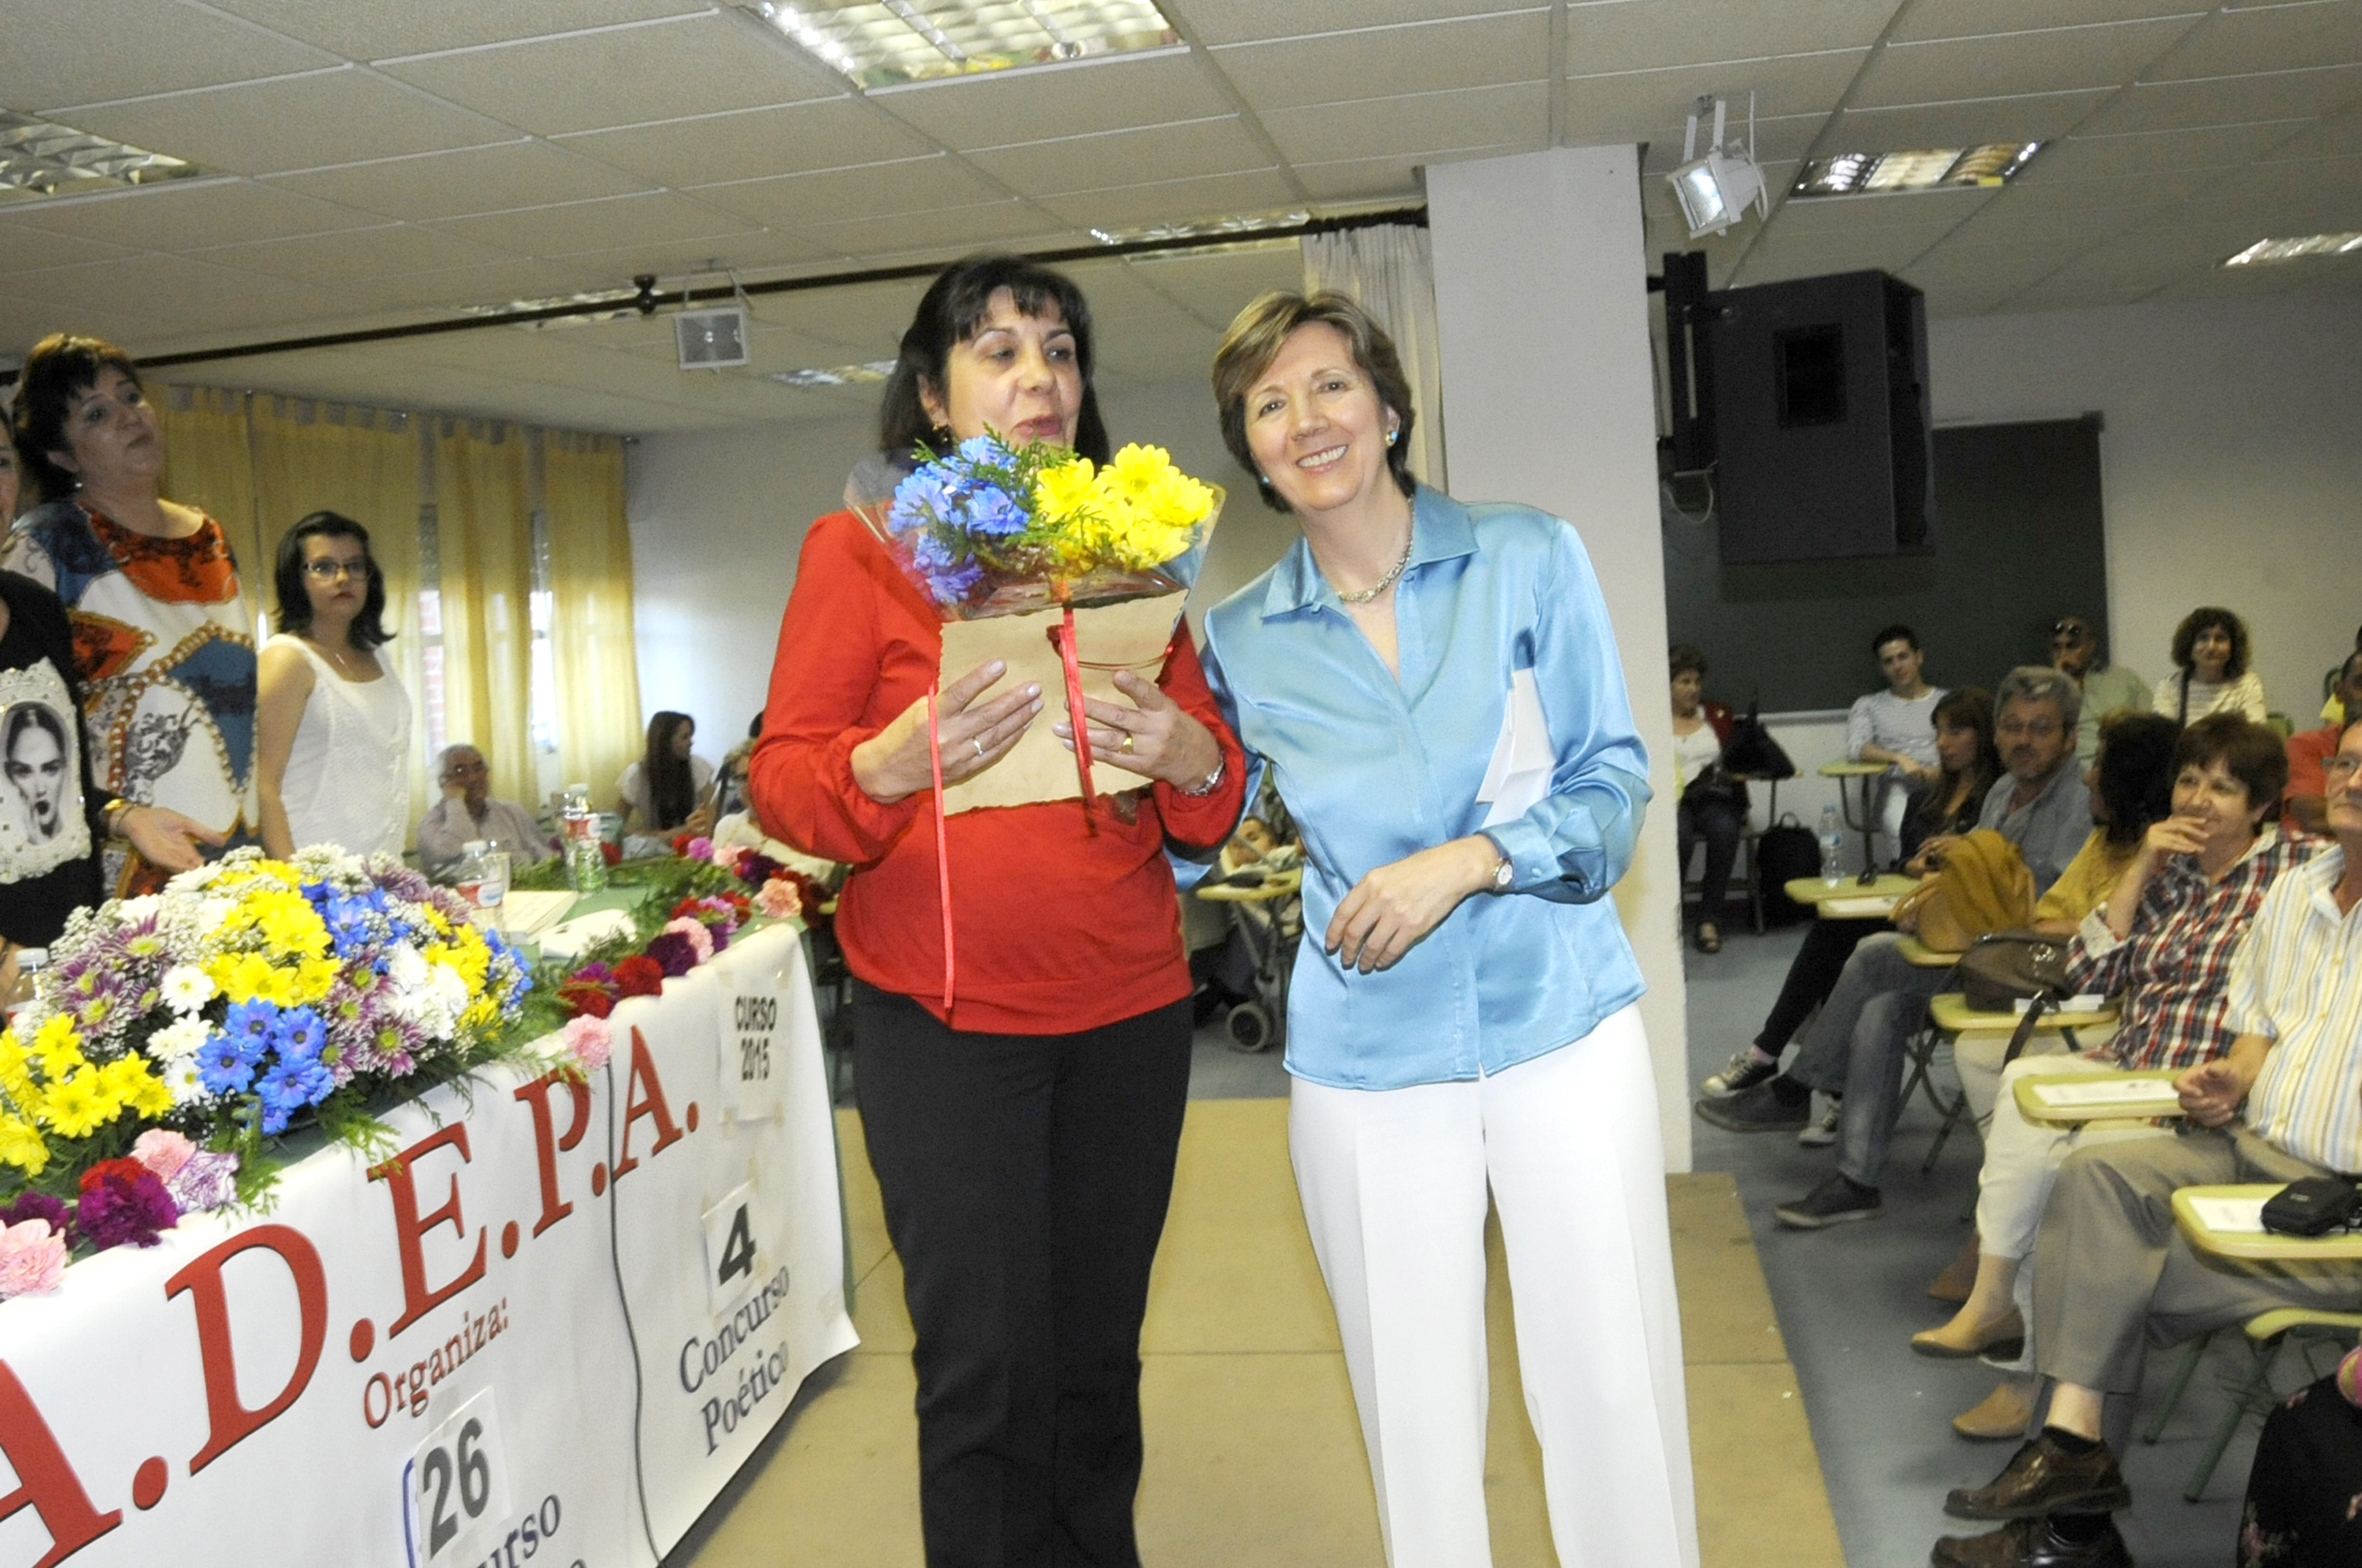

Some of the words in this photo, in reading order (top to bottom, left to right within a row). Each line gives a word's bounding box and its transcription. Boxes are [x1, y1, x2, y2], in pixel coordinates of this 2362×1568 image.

[734, 996, 777, 1032] CURSO
[741, 1037, 770, 1081] 2015
[718, 1202, 756, 1286] 4
[364, 1296, 508, 1429] Organiza:
[680, 1266, 790, 1393] Concurso
[701, 1341, 789, 1457] Poético
[423, 1417, 490, 1560] 26
